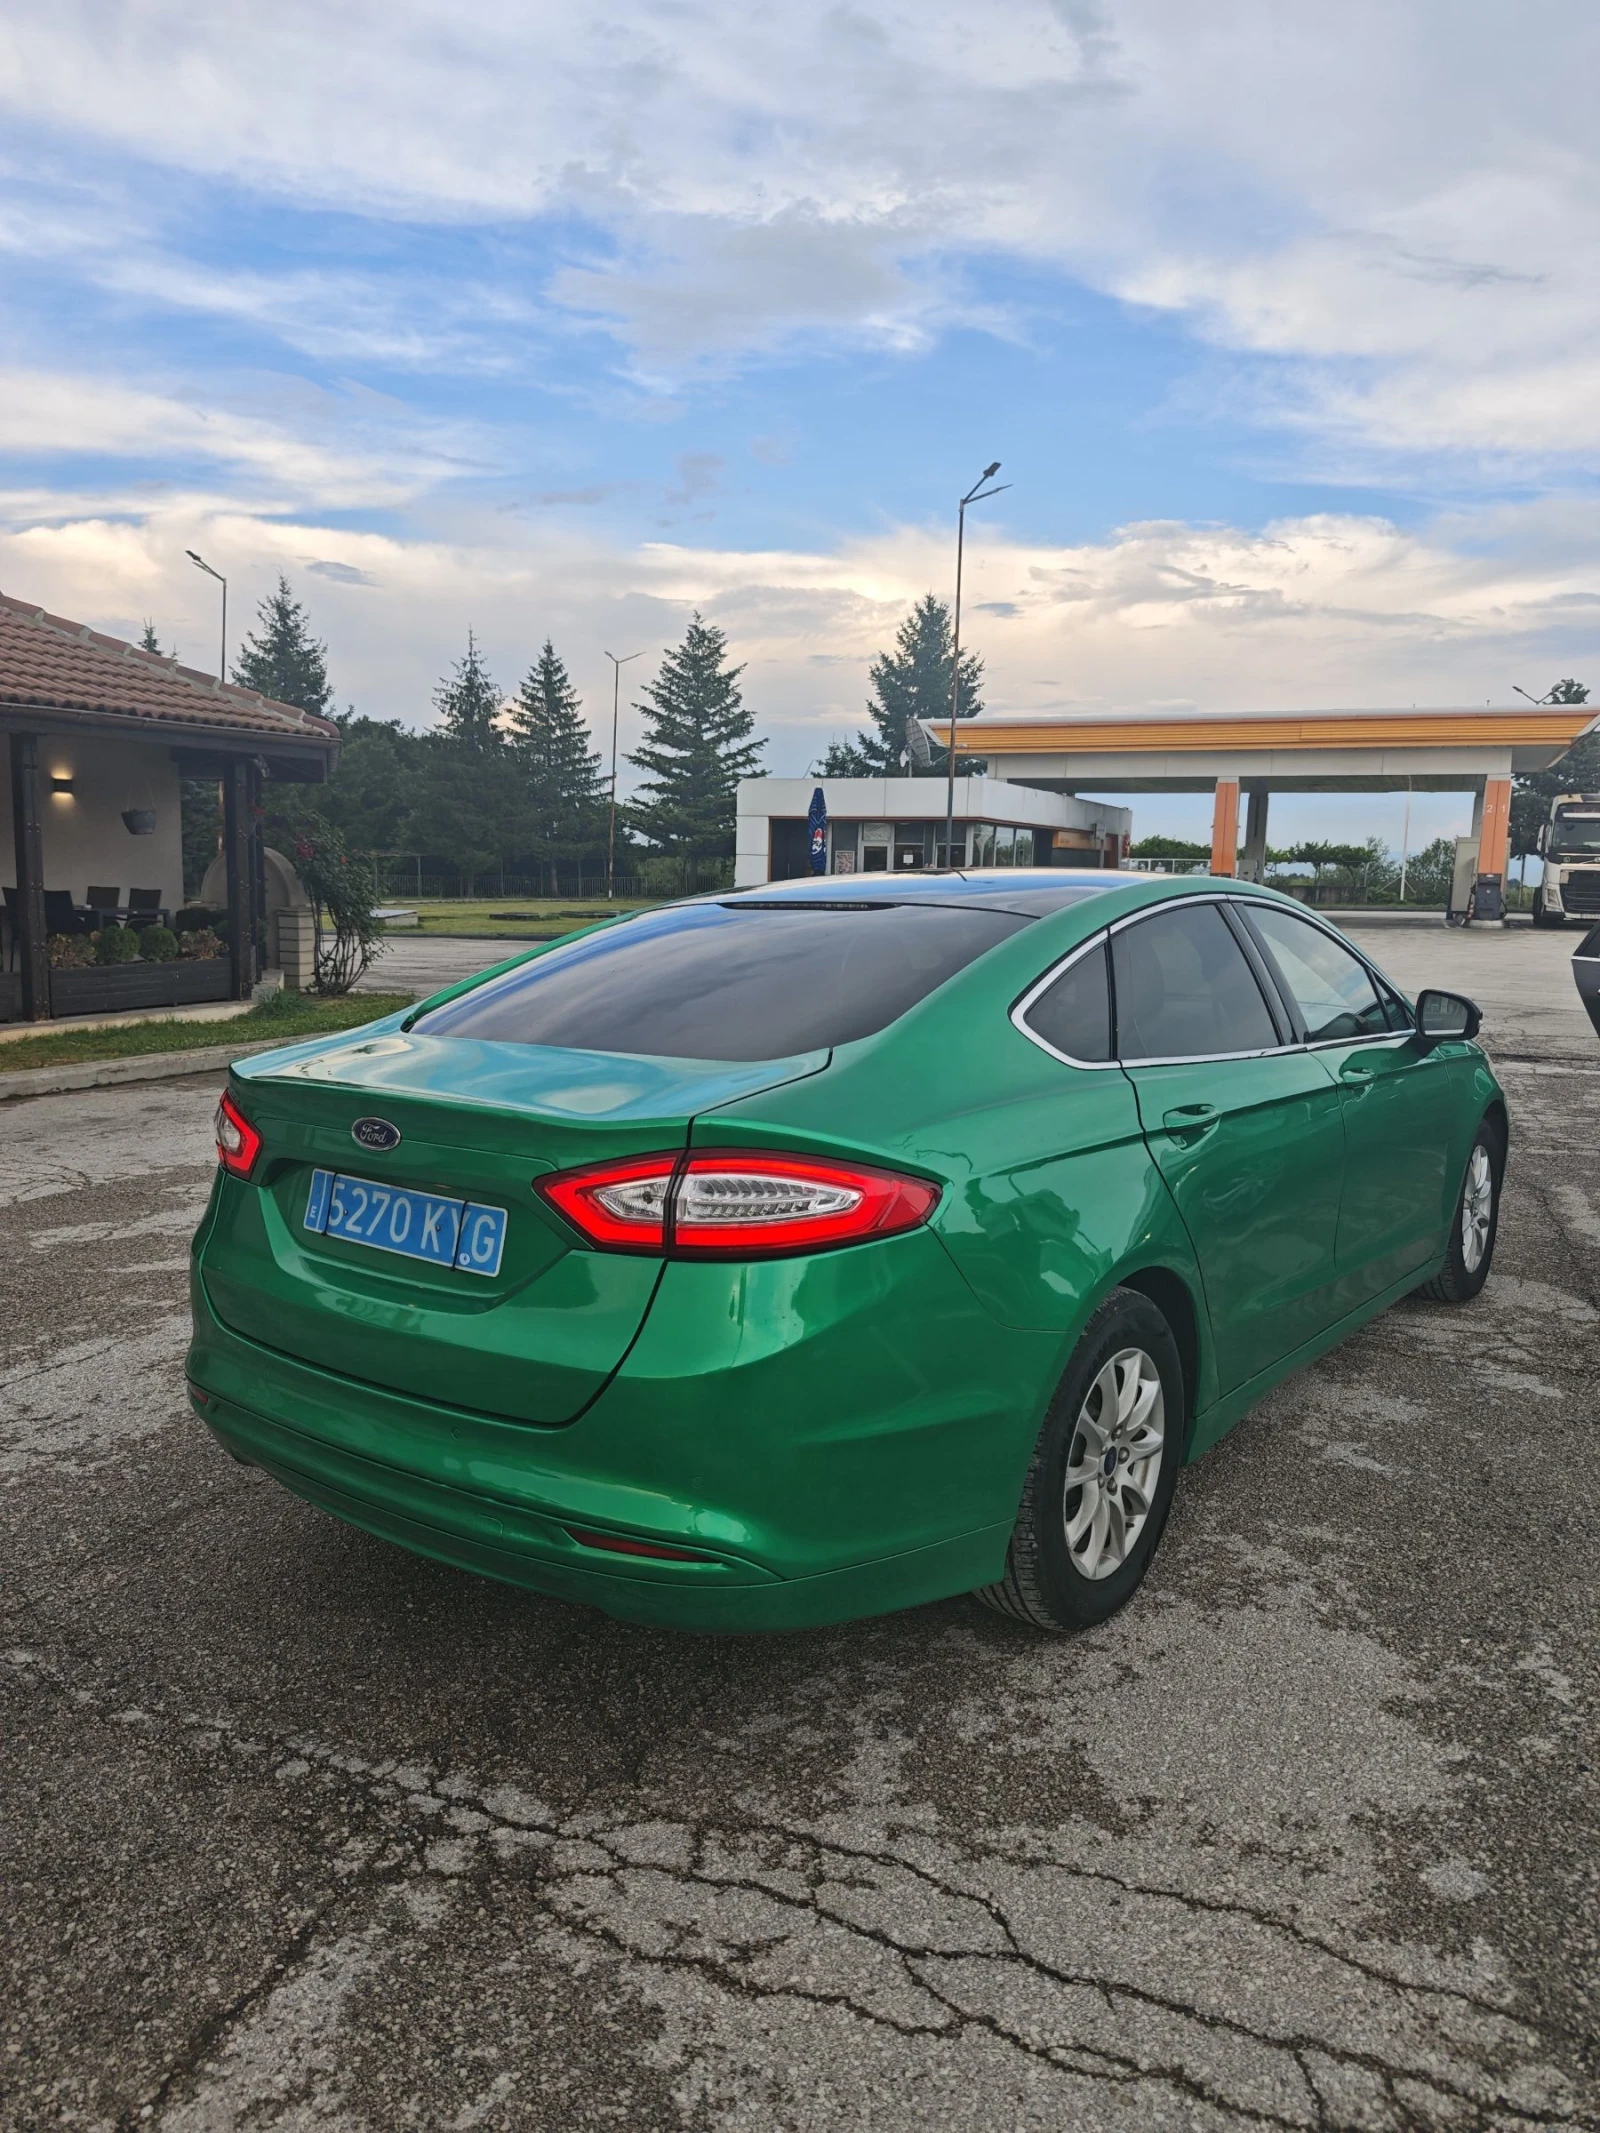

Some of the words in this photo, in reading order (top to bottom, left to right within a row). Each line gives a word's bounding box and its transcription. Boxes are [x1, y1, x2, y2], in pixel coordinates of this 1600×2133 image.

[1486, 804, 1493, 813] 2
[1501, 804, 1506, 813] 1
[360, 1123, 387, 1143] Ford
[309, 1206, 317, 1218] E
[328, 1182, 412, 1243] 5270
[420, 1202, 496, 1263] KYG
